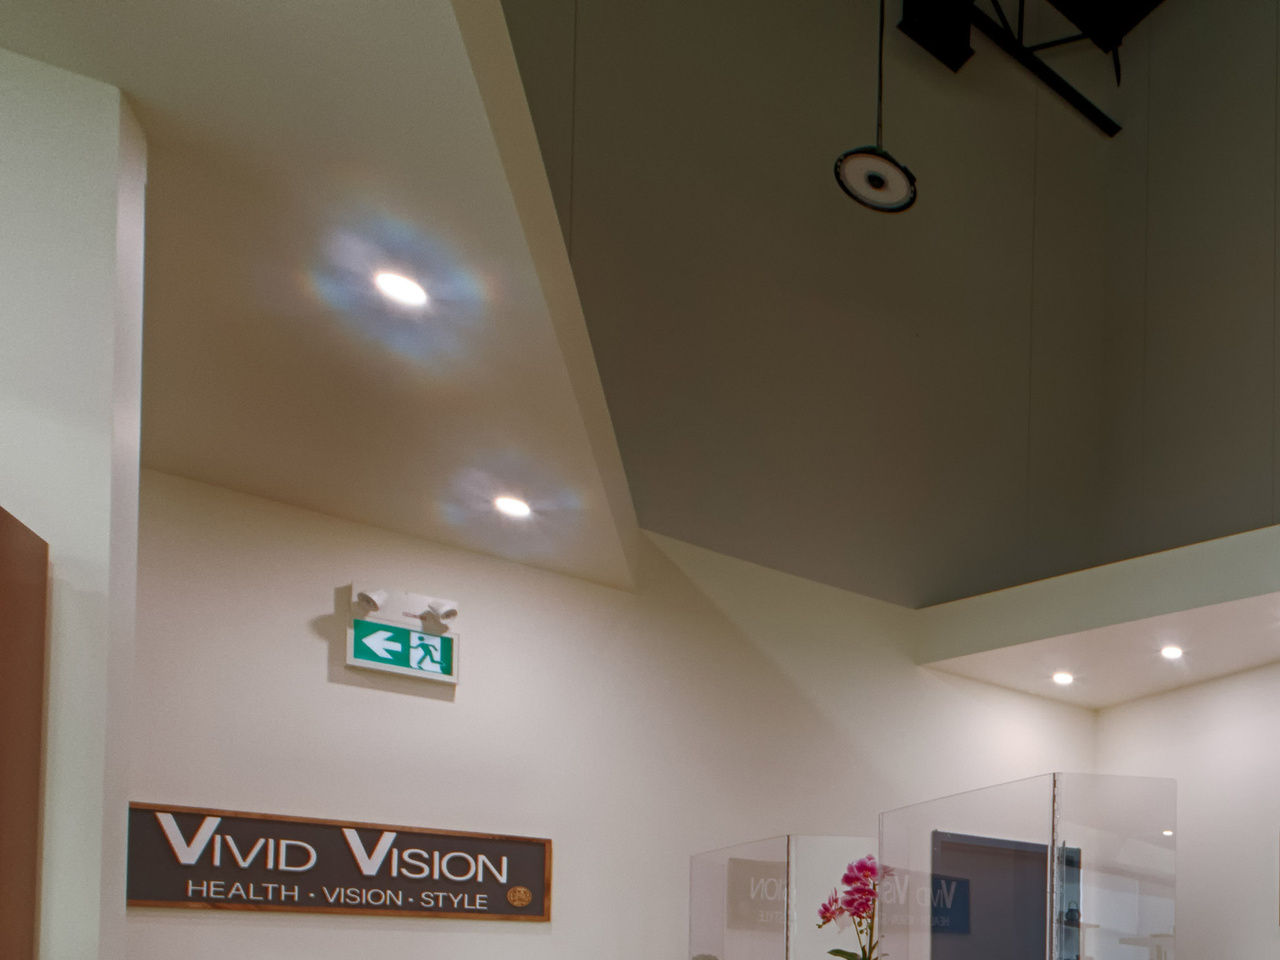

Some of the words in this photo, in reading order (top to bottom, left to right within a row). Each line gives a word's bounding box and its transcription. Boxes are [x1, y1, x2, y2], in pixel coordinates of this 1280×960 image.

[186, 879, 299, 901] HEALTH
[322, 886, 403, 906] VISION
[420, 891, 488, 910] STYLE
